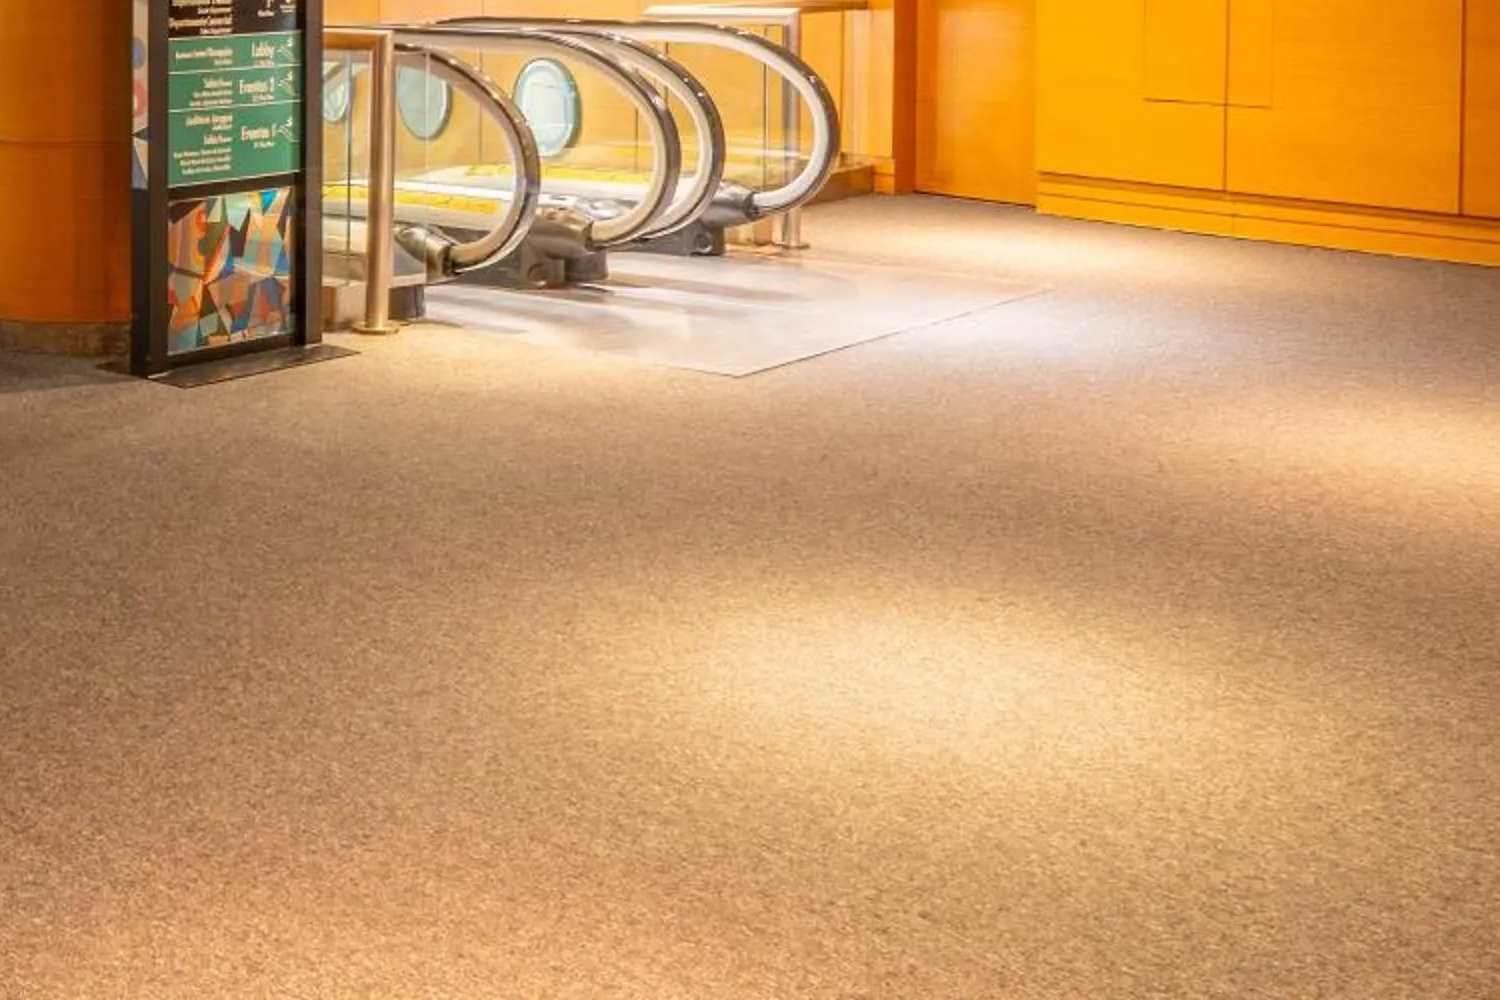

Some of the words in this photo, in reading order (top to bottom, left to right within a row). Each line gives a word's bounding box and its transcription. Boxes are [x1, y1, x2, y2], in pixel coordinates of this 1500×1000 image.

[251, 41, 274, 59] Lobby
[239, 80, 269, 94] Eventos
[241, 126, 270, 141] Eventos
